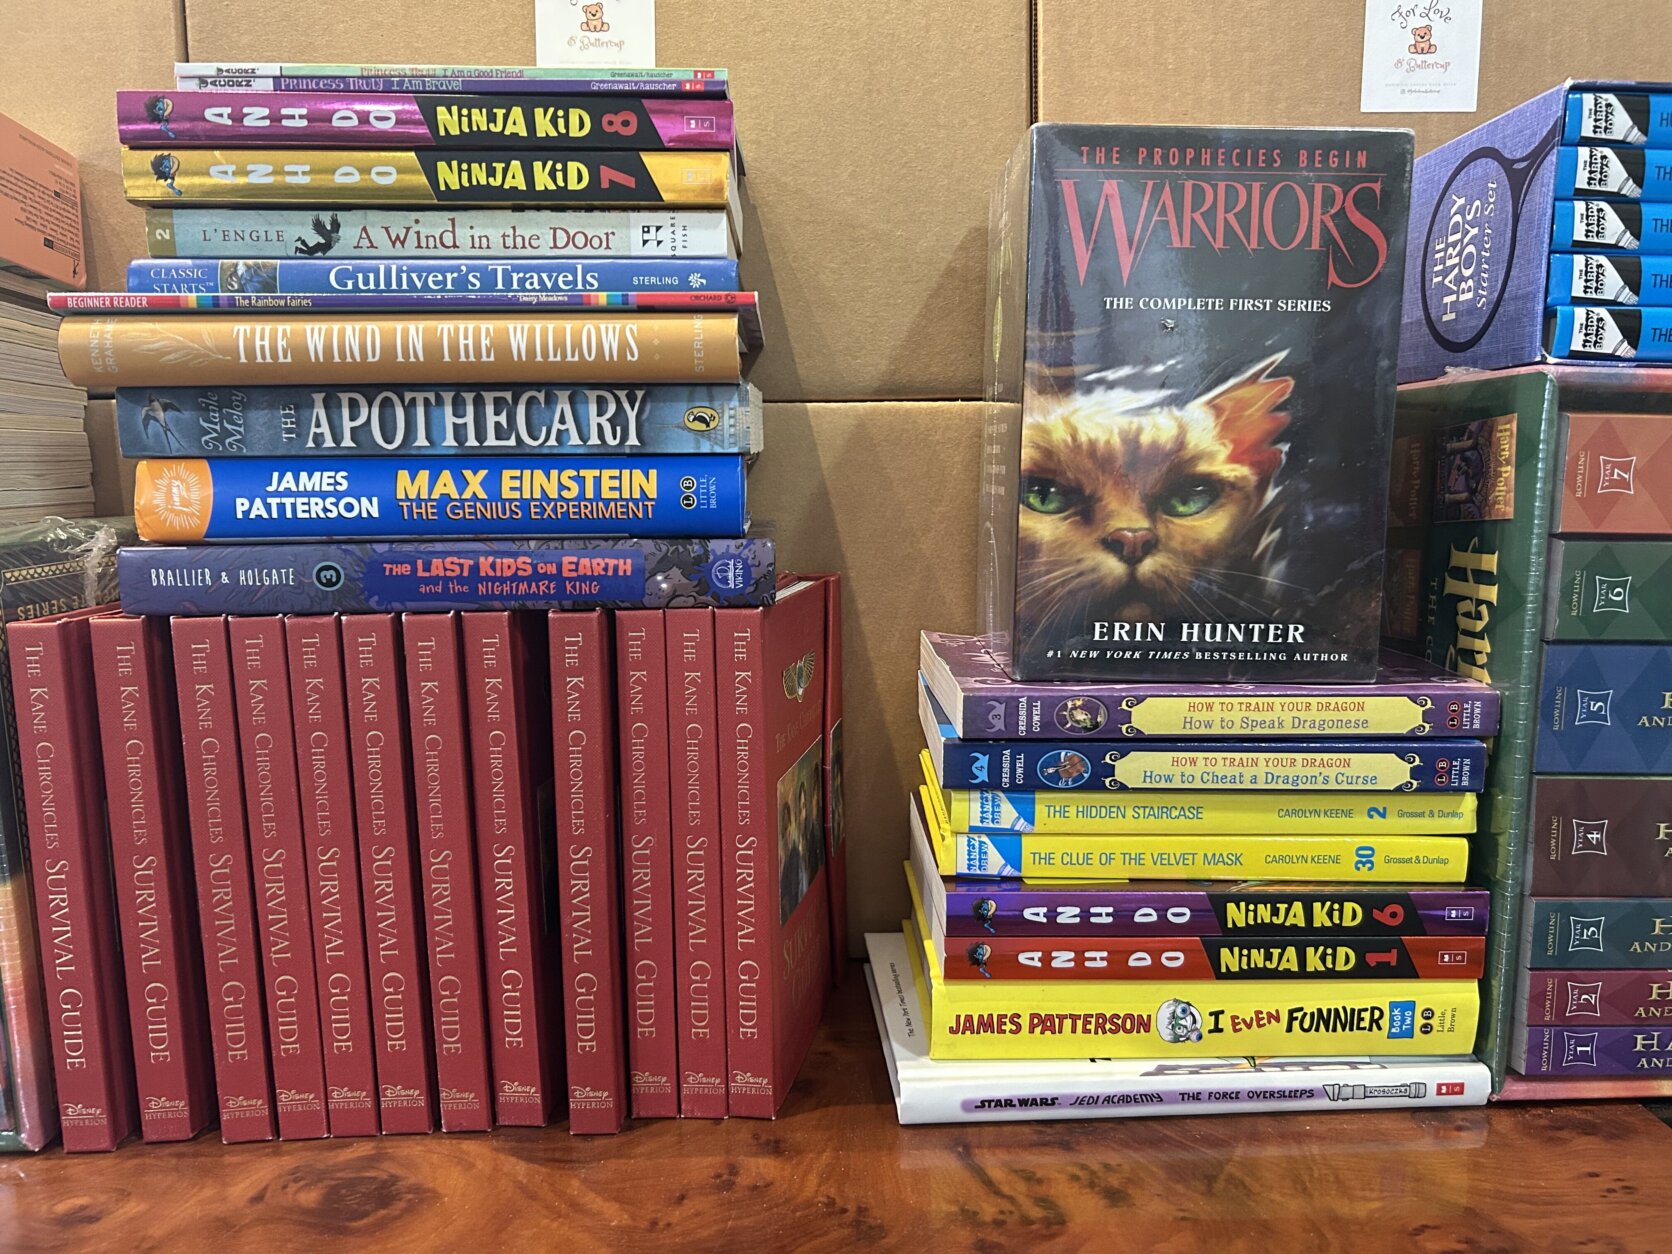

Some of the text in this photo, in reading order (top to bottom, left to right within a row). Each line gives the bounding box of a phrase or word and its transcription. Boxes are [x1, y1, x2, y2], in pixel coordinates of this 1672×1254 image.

[281, 78, 344, 90] Princess
[391, 78, 400, 90] I
[402, 79, 423, 90] Am
[425, 79, 462, 91] Brave!
[590, 81, 677, 91] Greenawalt/Rauscher
[204, 106, 397, 129] ANH DO
[601, 110, 638, 136] 8
[1080, 146, 1369, 169] THE PROPHECIES BEGIN
[209, 164, 398, 185] ANH DO
[600, 165, 637, 190] 7
[202, 229, 285, 243] L'ENGLE
[352, 218, 616, 250] A Wind in the Door
[669, 215, 677, 257] SQUARE
[1054, 177, 1388, 290] WARRIORS
[1476, 180, 1497, 310] Starter Set
[1432, 234, 1447, 288] THE
[1441, 194, 1466, 322] HARDY
[1458, 199, 1482, 302] BOYS
[150, 268, 208, 279] CLASSIC
[329, 264, 599, 290] Gulliver's Travels
[632, 275, 679, 285] STERLING
[67, 296, 148, 308] BEGINNER READER
[235, 296, 312, 308] The Rainbow Fairies
[1104, 296, 1331, 313] THE COMPLETE FIRST SERIES
[233, 322, 639, 363] THE WIND IN THE WILLOWS
[198, 391, 223, 451] Maile
[223, 390, 247, 453] Meloy
[280, 390, 646, 450] THE APOTHECARY
[1494, 423, 1511, 512] Harry Potter
[1575, 450, 1585, 498] ROWLING
[265, 471, 349, 492] JAMES
[396, 469, 657, 500] MAX EINSTEIN
[700, 474, 708, 509] LITTLE,
[709, 476, 717, 509] BROWN
[235, 497, 379, 519] PATTERSON
[399, 501, 656, 520] THE GENIUS EXPERIMENT
[150, 568, 295, 586] BRALLIER & HOLGATE
[416, 556, 474, 577] LAST
[479, 555, 532, 577] KIDS
[561, 555, 632, 578] EARTH
[735, 559, 743, 589] VIKING
[419, 580, 600, 596] and the NIGHTMARE KING
[1092, 621, 1306, 644] ERIN HUNTER
[1046, 650, 1349, 662] #1 NEW YORK TIMES BESTSELLING AUTHOR
[1018, 696, 1028, 736] CRESSIDA
[1032, 700, 1041, 732] COWELL
[1188, 701, 1365, 712] HOW TO TRAIN YOUR DRAGON
[1182, 716, 1369, 732] How to Speak Dragonese
[1142, 769, 1378, 788] How to Cheat a Dragon's Curse
[1045, 804, 1204, 820] THE HIDDEN STAIRCASE
[1277, 806, 1387, 819] CAROLYN KEENE 2
[733, 628, 761, 1040] THE KANE CHRONICLES SURVIVAL GUIDE
[1030, 852, 1243, 867] THE CLUE OF THE VELVET MASK
[1354, 845, 1449, 872] 30 Grosset & Dunlap
[1372, 903, 1405, 926] 6
[1365, 949, 1398, 967] 1
[948, 1012, 1152, 1036] JAMES PATTERSON
[1207, 1010, 1225, 1033] I
[1285, 1005, 1384, 1033] FUNNIER
[731, 1085, 773, 1096] HYPERION
[1069, 1092, 1164, 1106] JEDI ACADEMY
[1178, 1089, 1315, 1101] THE FORCE OVERSLEEPS
[974, 1096, 1059, 1109] STAR WARS
